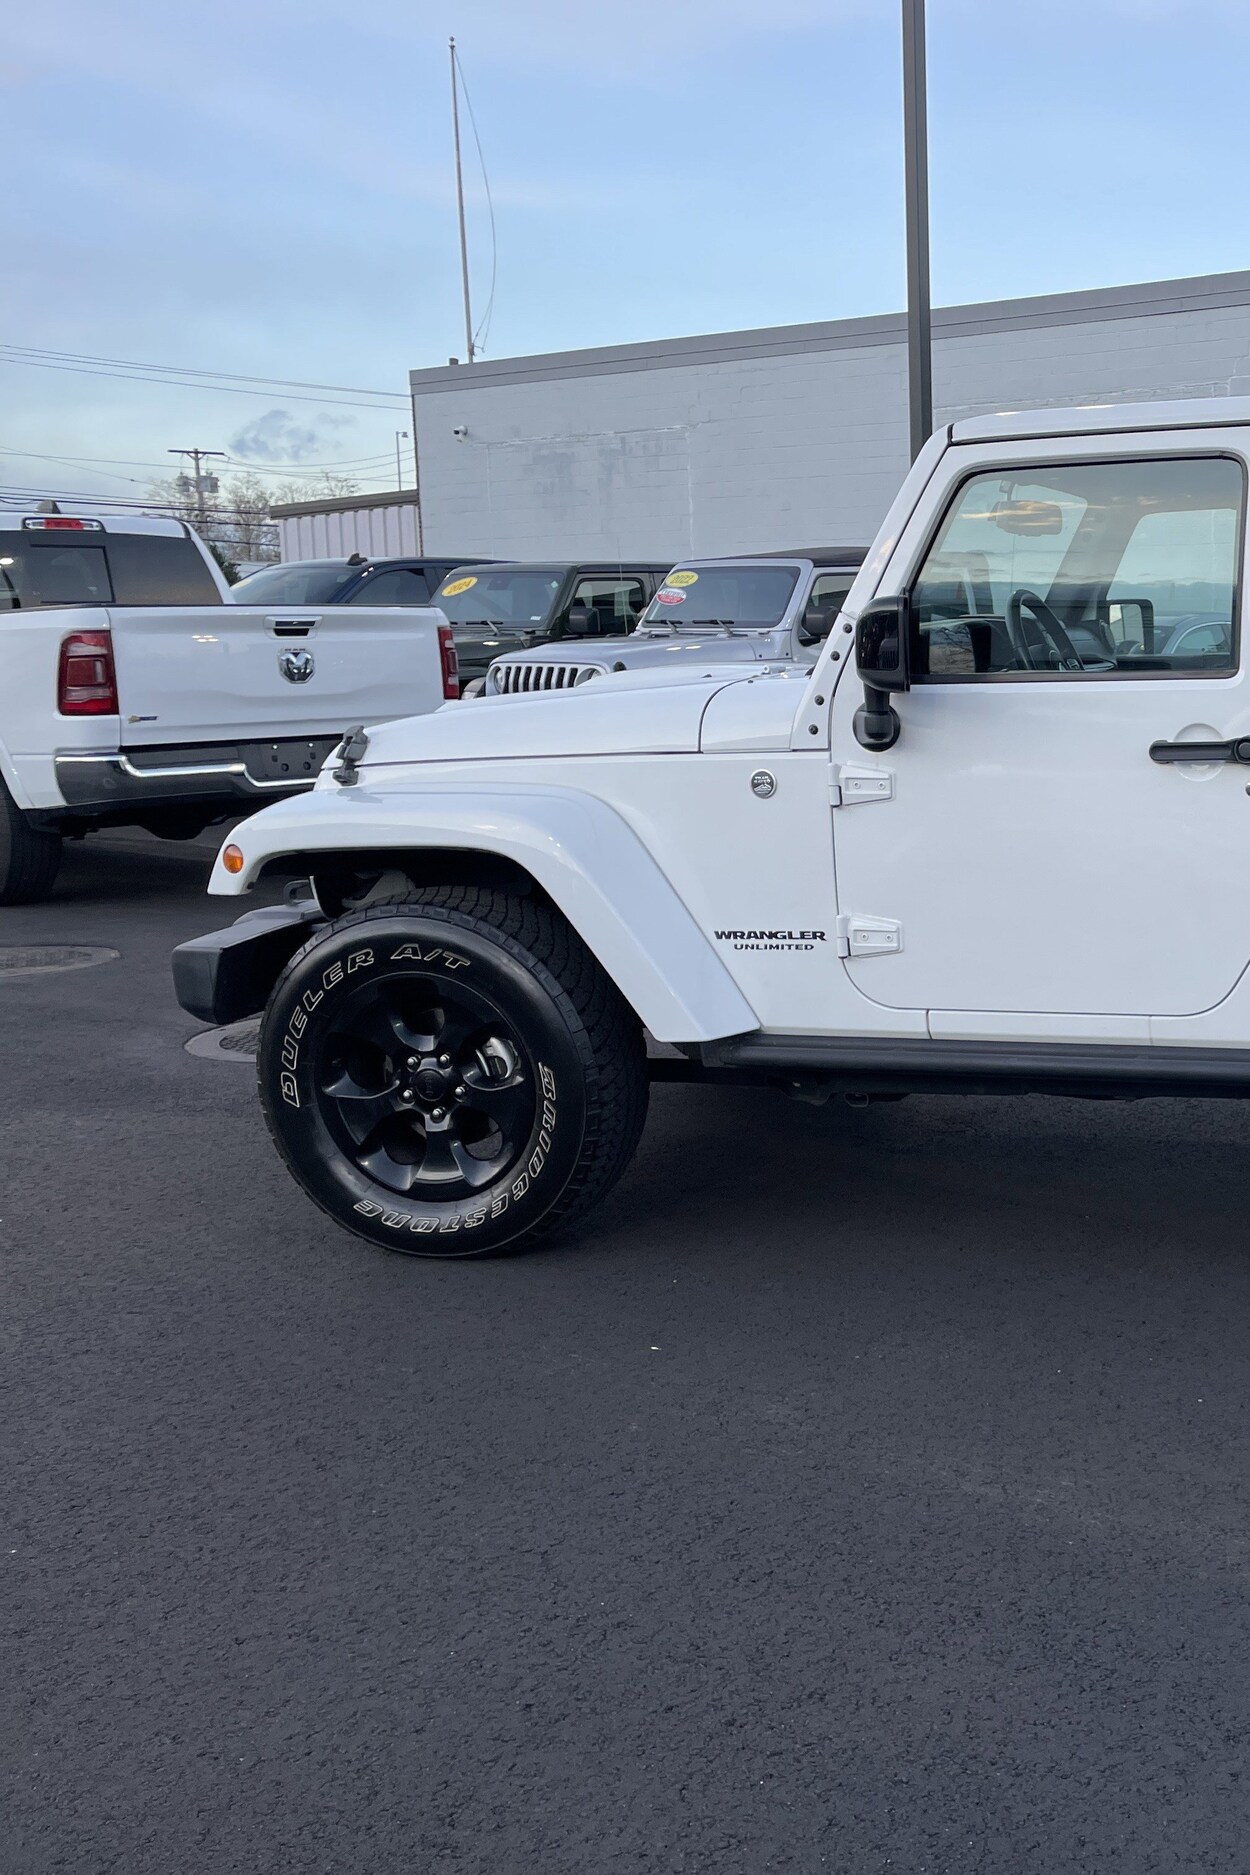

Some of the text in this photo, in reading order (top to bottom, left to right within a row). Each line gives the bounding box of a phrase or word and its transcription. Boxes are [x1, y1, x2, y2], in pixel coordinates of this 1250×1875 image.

[714, 930, 828, 941] WRANGLER
[734, 943, 815, 951] UNLIMITED
[280, 942, 471, 1108] DUELER A/T
[353, 1060, 557, 1234] BRIDGESTONE
